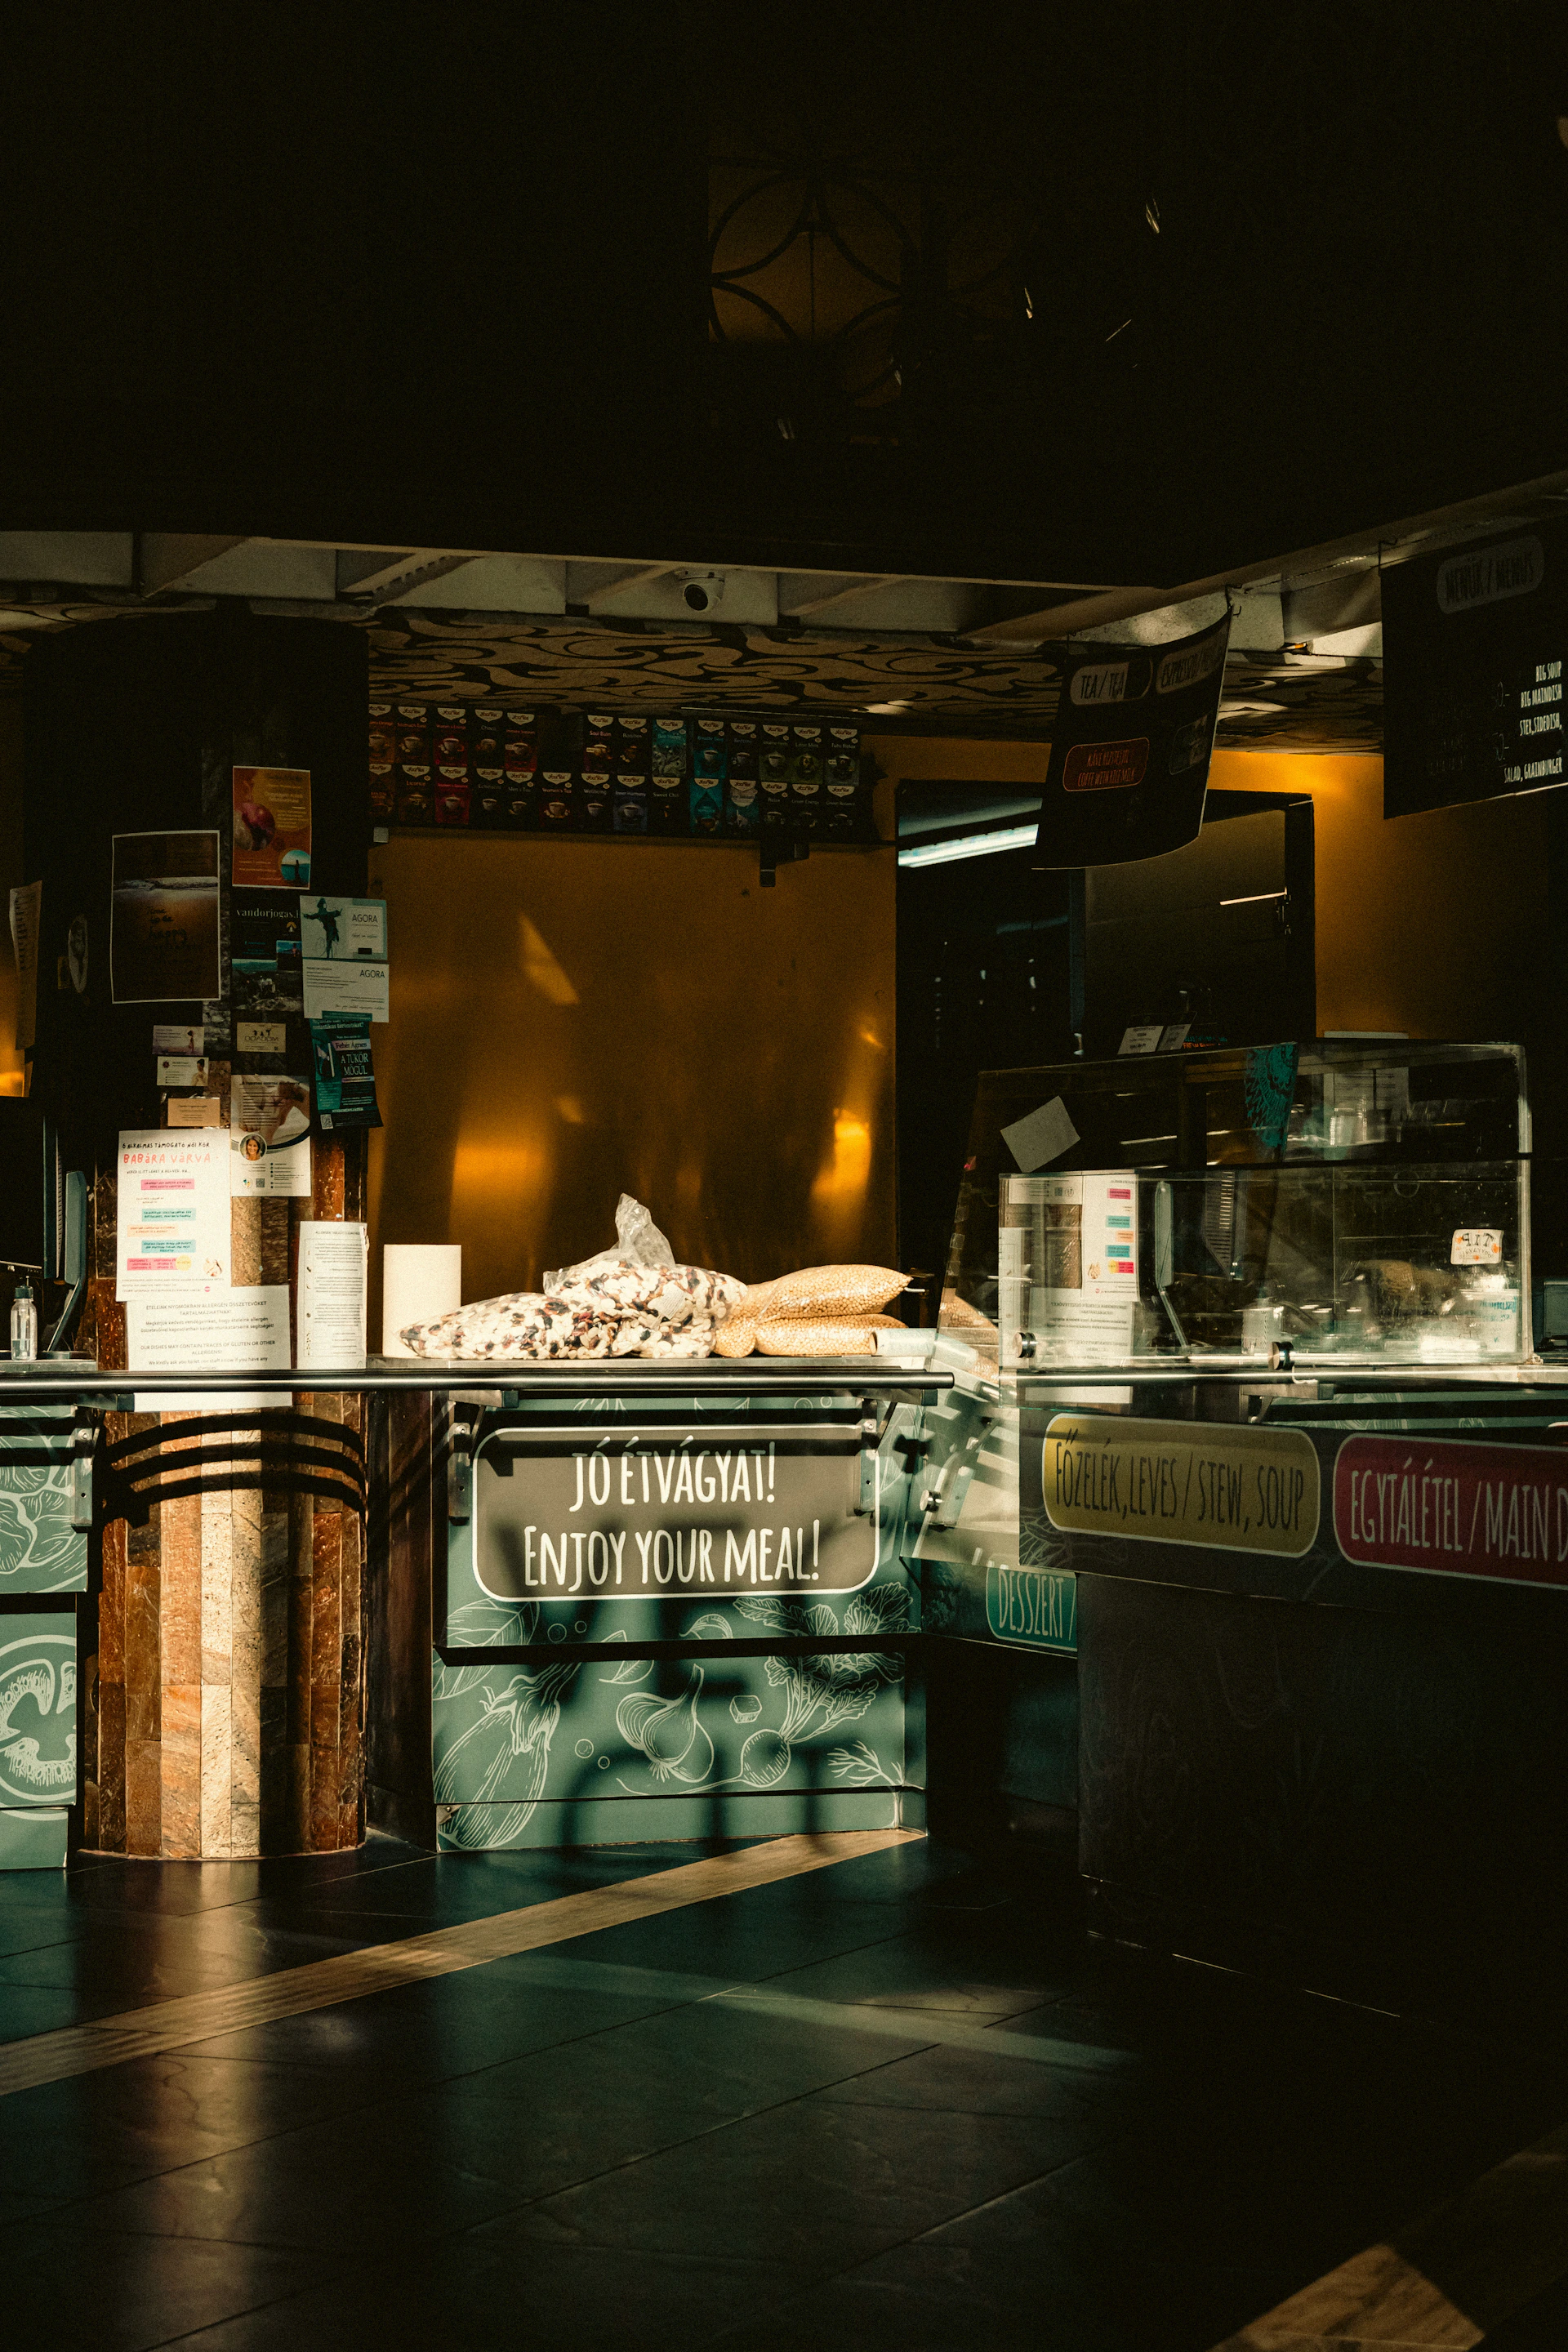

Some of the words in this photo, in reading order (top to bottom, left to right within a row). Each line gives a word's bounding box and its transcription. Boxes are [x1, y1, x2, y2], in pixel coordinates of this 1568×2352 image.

[1535, 664, 1547, 683] BIG
[1547, 660, 1561, 680] SOUP
[1080, 674, 1098, 699] TEA
[1521, 690, 1531, 708] BIG
[1504, 765, 1523, 783] SALAD,
[352, 914, 378, 923] AGORA
[359, 969, 385, 978] AGORA
[170, 1152, 211, 1164] VÁRVA
[569, 1436, 611, 1512] JÓ
[621, 1434, 776, 1504] ÉTVÁGYAT!
[1198, 1459, 1250, 1533] STEW,
[1256, 1465, 1304, 1531] SOUP
[1350, 1455, 1463, 1552] EGYTÁLÉTEL
[1485, 1481, 1550, 1561] MAIN
[635, 1528, 715, 1584] YOUR
[724, 1518, 820, 1584] MEAL!
[998, 1568, 1065, 1639] DESSZERT
